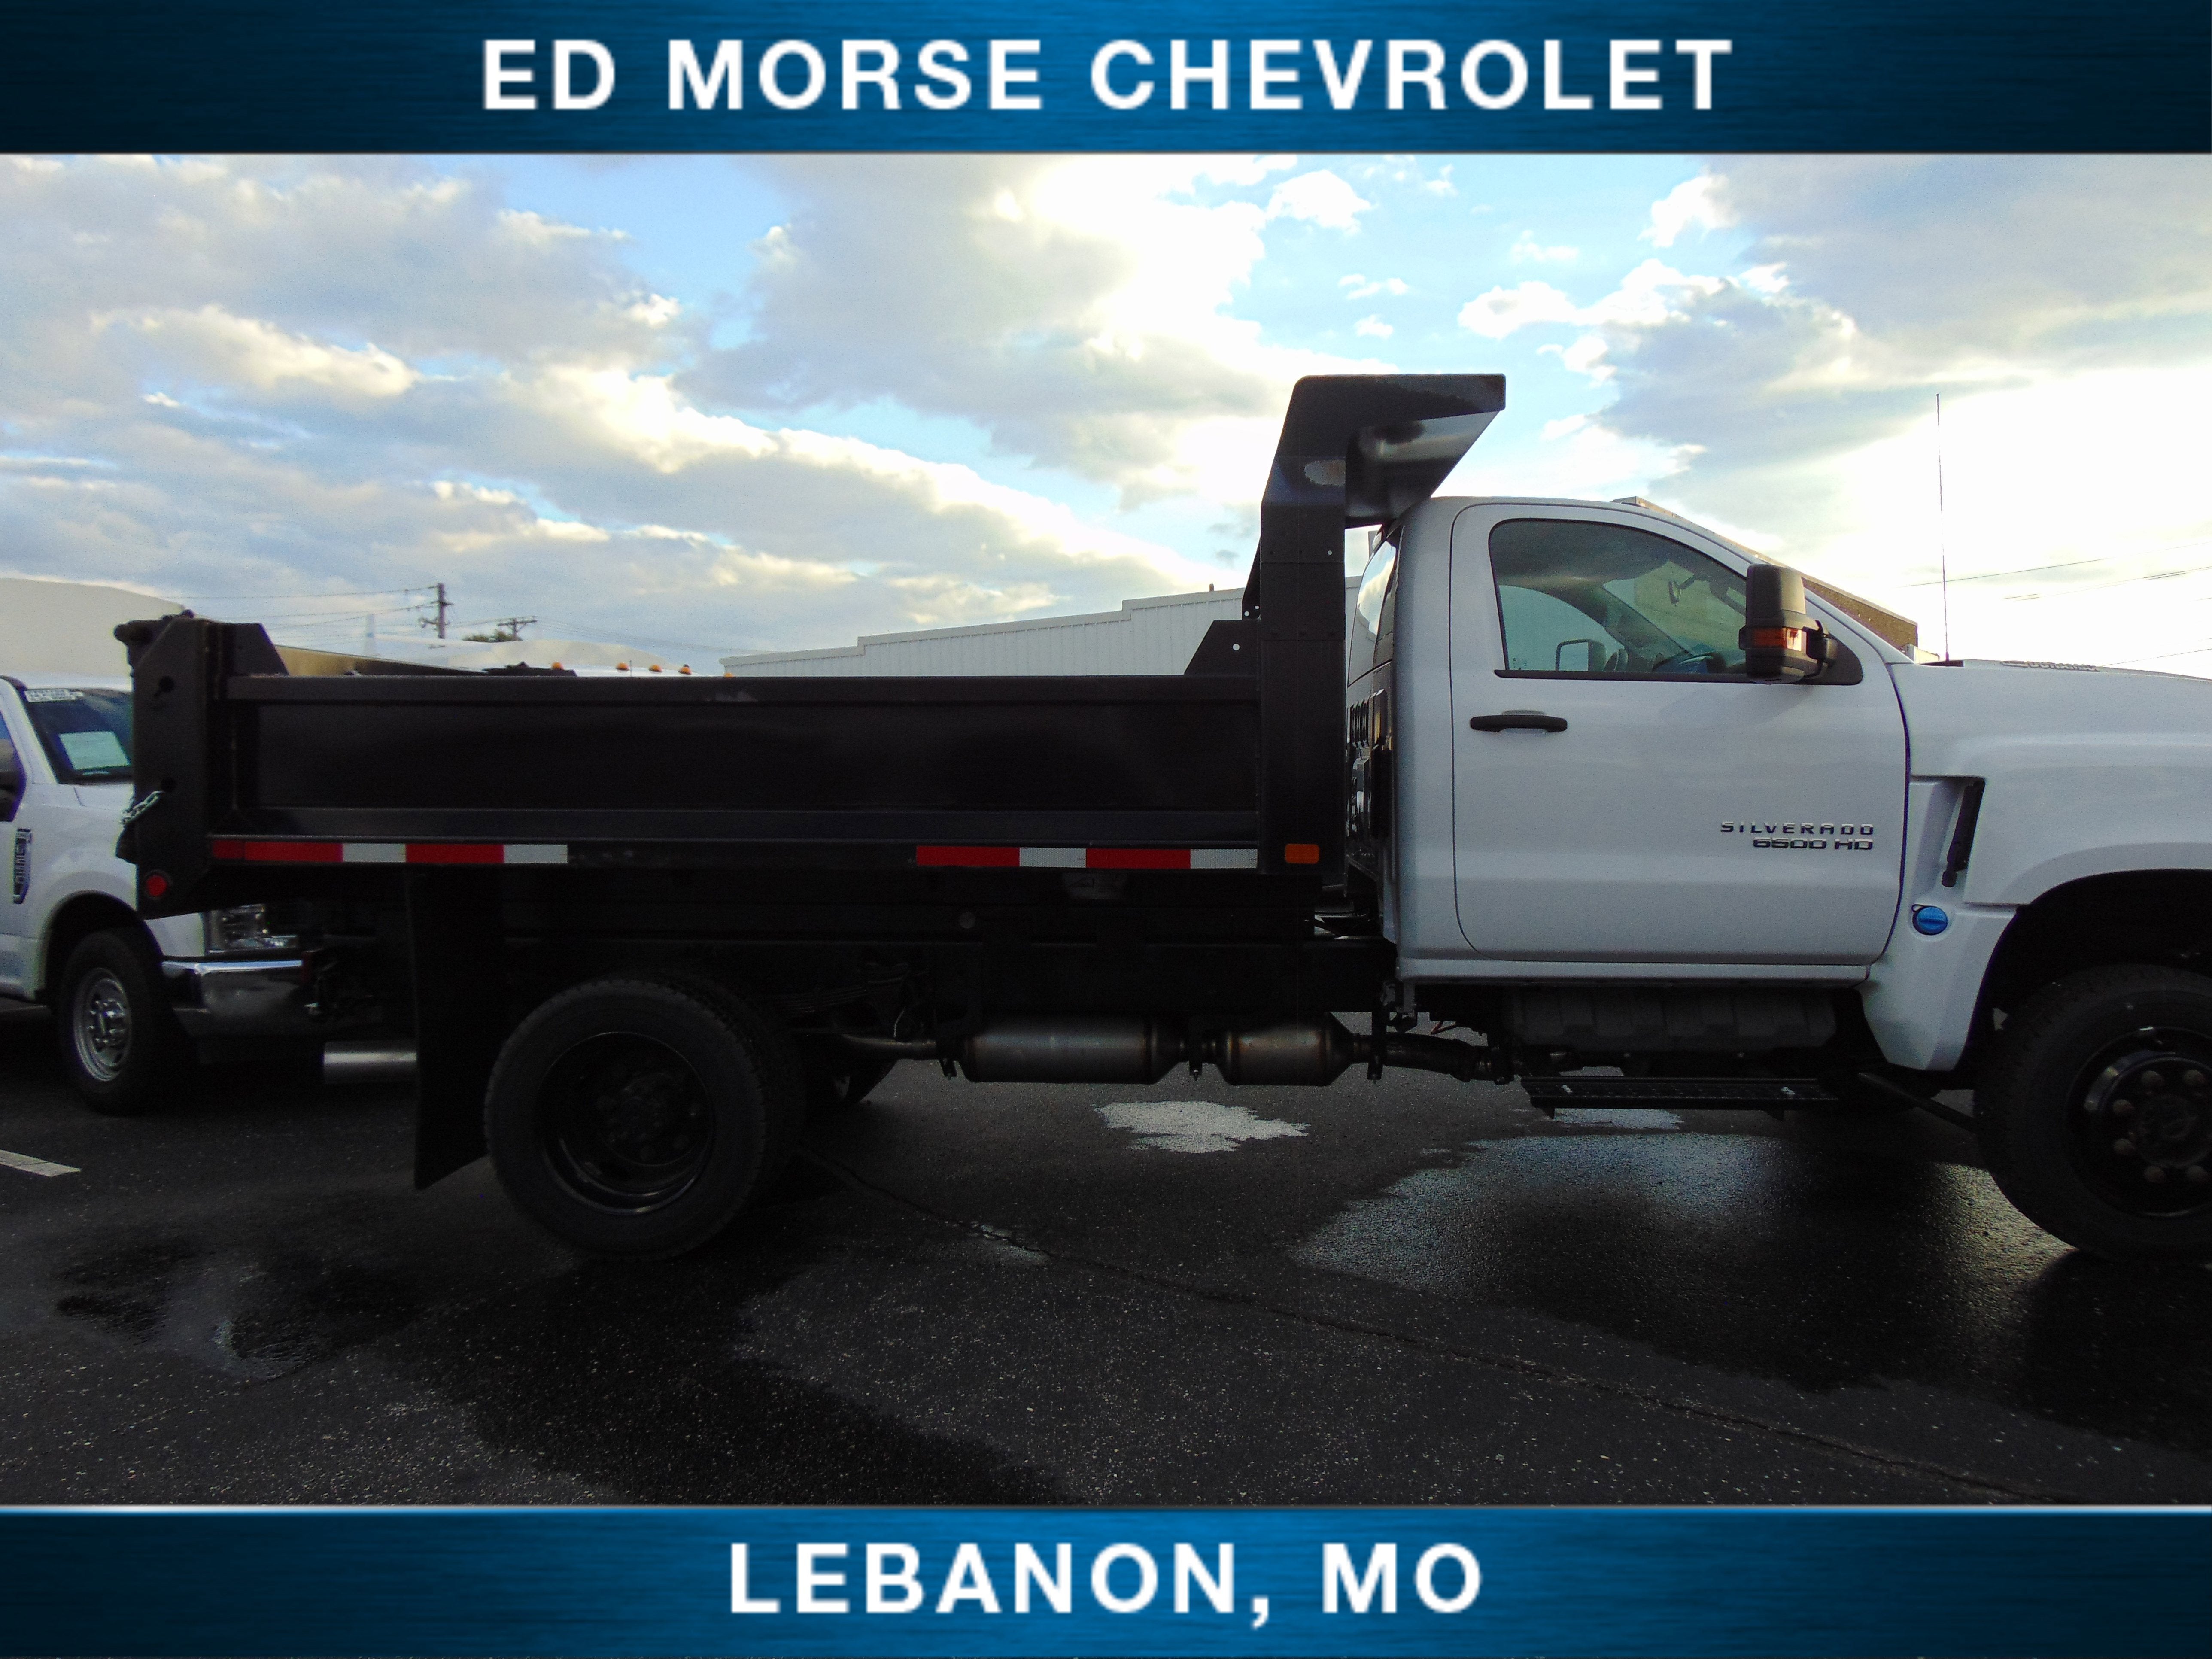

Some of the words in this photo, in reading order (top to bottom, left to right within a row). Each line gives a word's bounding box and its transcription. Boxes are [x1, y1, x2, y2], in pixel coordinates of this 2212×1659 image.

[1720, 821, 1874, 835] SILVERADO
[1753, 837, 1826, 849] 6500
[1834, 839, 1873, 850] HD
